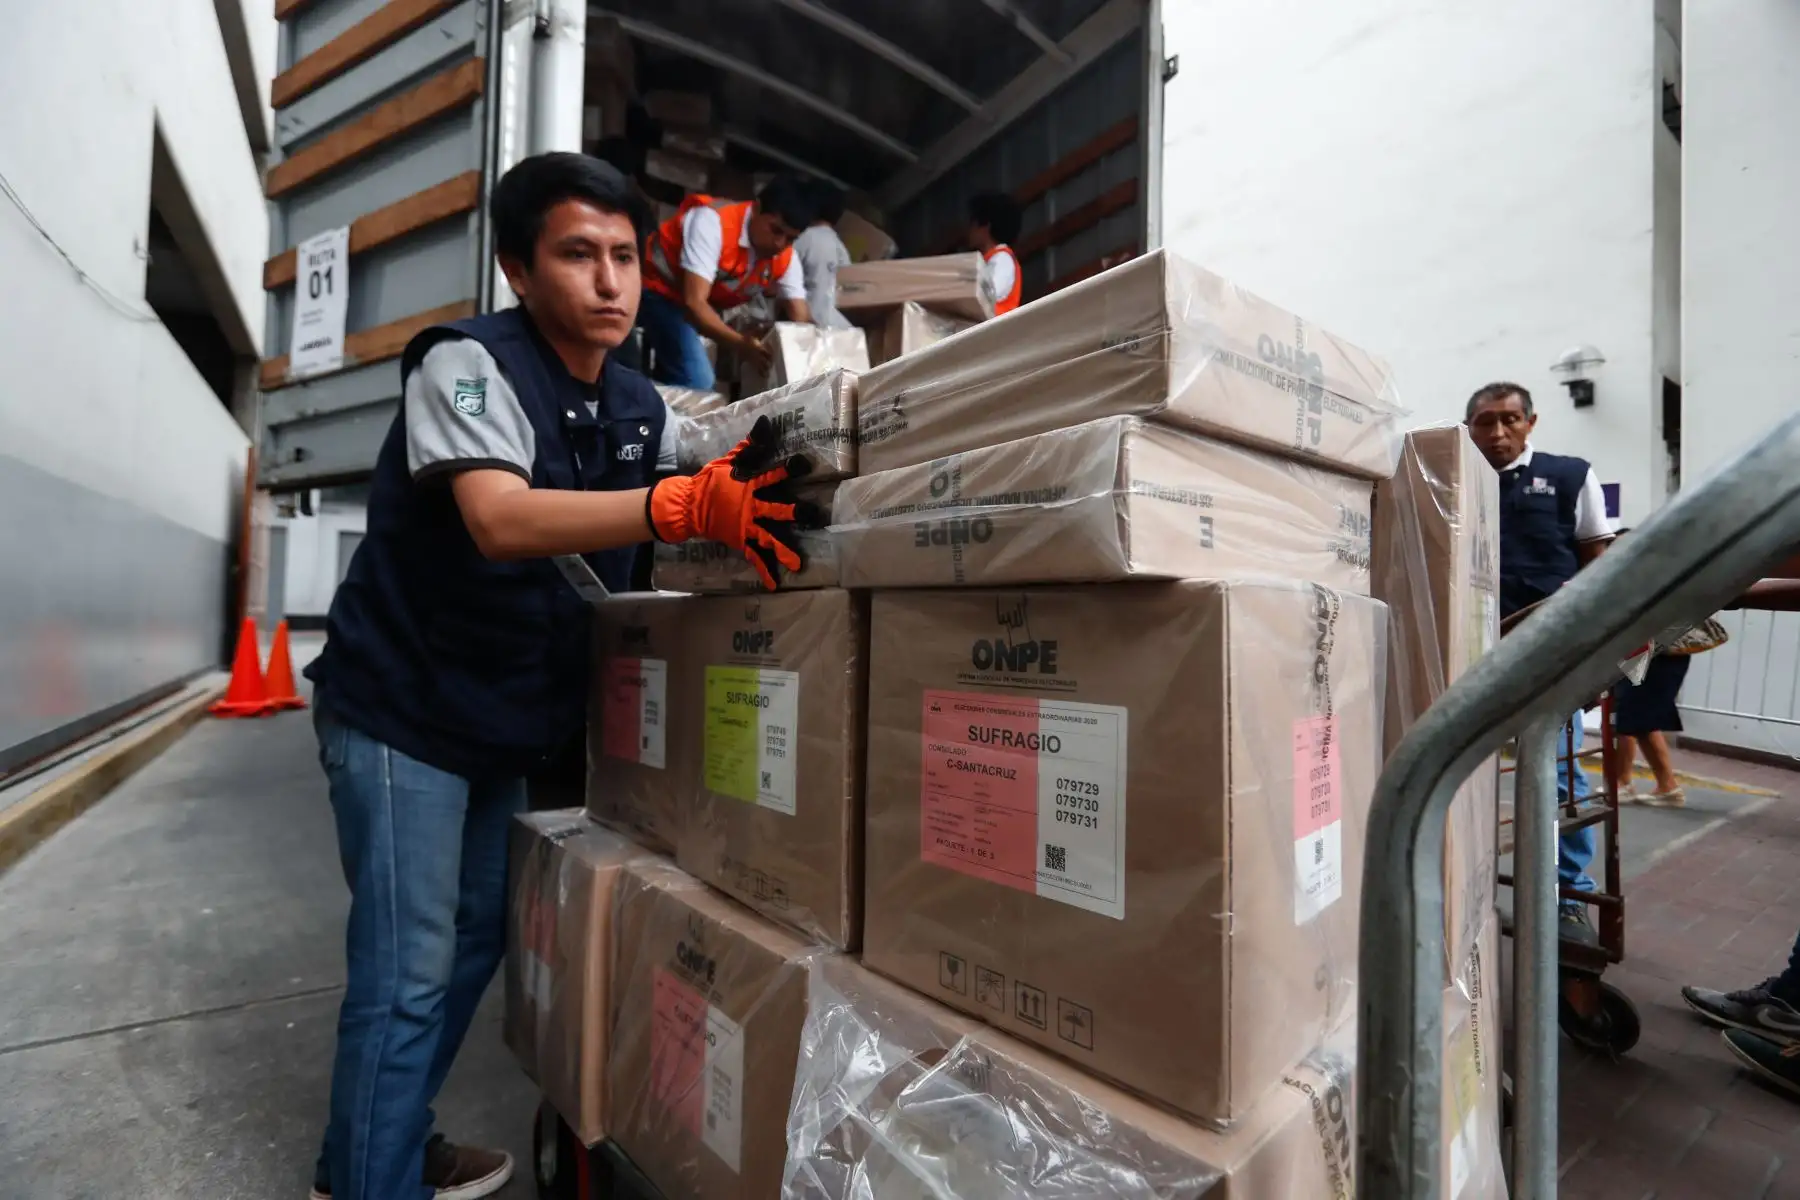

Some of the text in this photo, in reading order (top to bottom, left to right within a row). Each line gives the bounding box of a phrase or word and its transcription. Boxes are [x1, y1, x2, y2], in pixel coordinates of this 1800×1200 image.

[309, 265, 333, 299] 01
[1275, 373, 1287, 391] DE
[914, 518, 995, 547] ONPE
[732, 630, 774, 655] ONPE
[971, 638, 1058, 675] ONPE
[726, 691, 770, 709] SUFRAGIO
[967, 724, 1062, 754] SUFRAGIO
[946, 758, 1017, 780] C-SANTACRUZ
[1056, 777, 1099, 796] 079729
[1055, 793, 1099, 813] 079730
[1055, 810, 1098, 829] 079731
